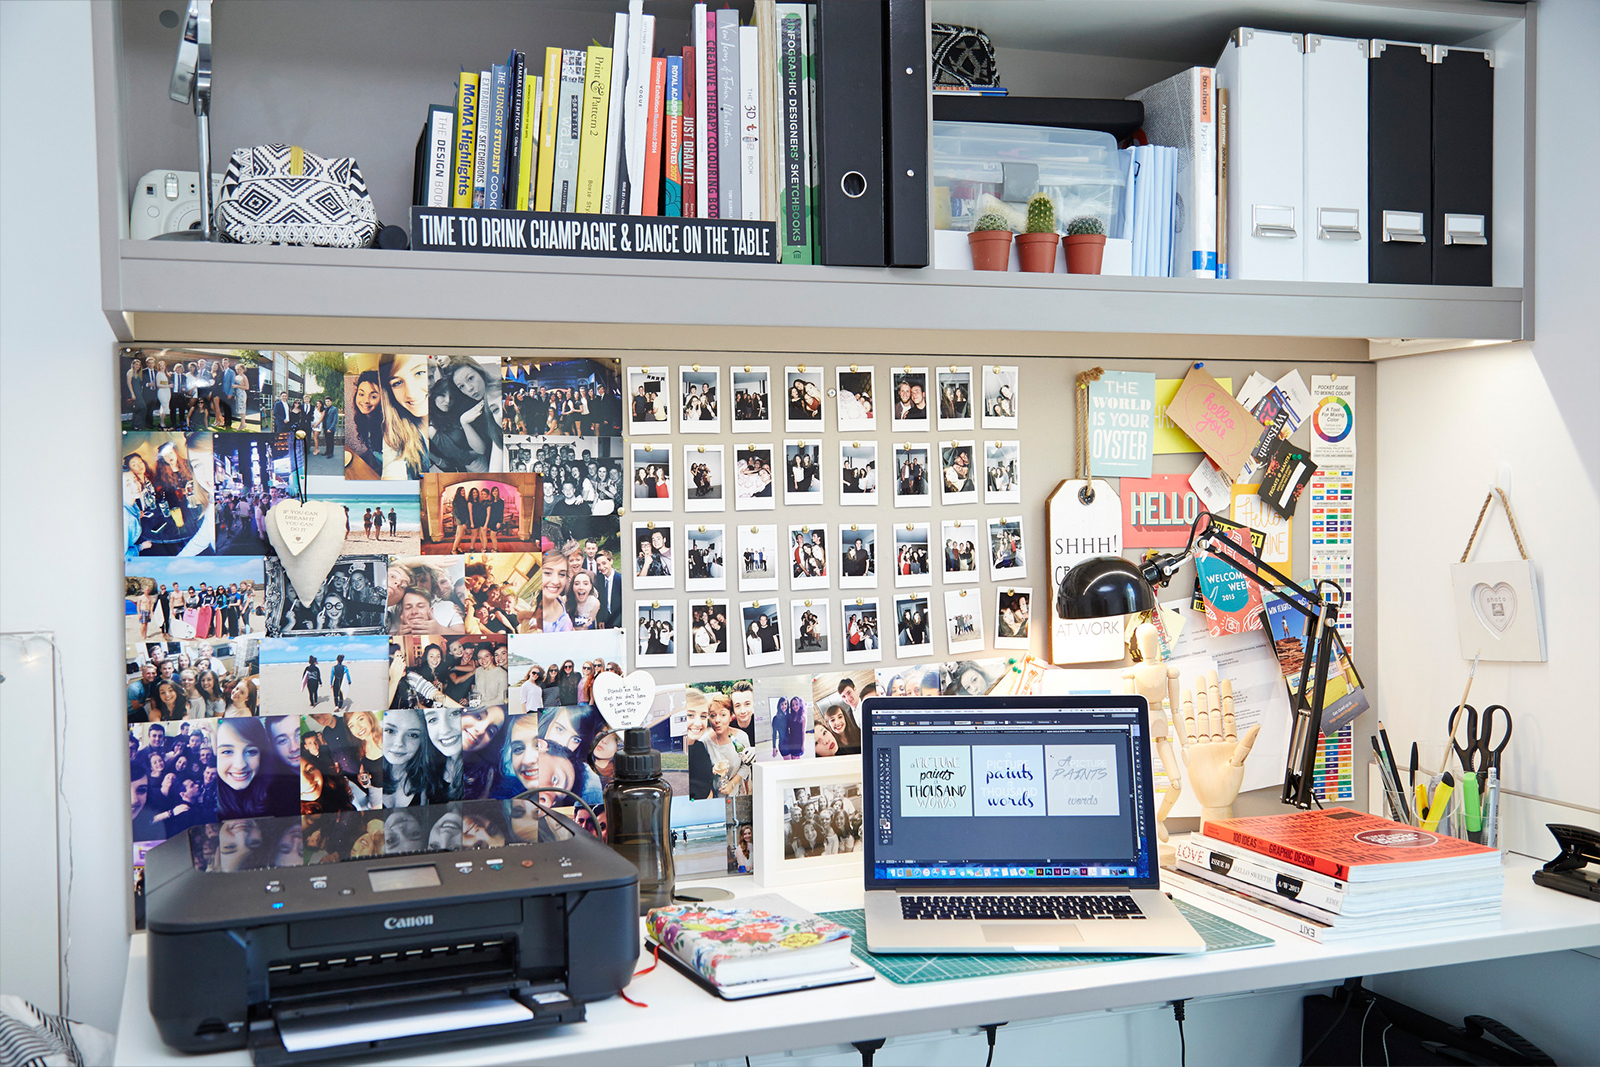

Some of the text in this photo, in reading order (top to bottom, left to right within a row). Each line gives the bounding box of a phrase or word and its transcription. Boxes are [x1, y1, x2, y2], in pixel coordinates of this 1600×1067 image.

[720, 21, 736, 40] New
[549, 54, 557, 77] Summer
[594, 56, 605, 79] Print
[707, 40, 716, 88] CREATIVE
[787, 22, 797, 96] INFOGRAPHIC
[516, 89, 523, 98] DE
[547, 78, 555, 106] Exhibition
[590, 80, 605, 96] &
[1202, 75, 1210, 116] bauhaus
[514, 98, 522, 131] LEMPICKA
[590, 96, 602, 129] Pattern
[707, 90, 717, 133] THERAPY
[745, 105, 756, 119] 3D
[438, 117, 448, 136] THE
[476, 77, 490, 184] EXTRAORDINARY SKETCHBOOKS
[491, 71, 506, 175] THE HUNGRY STUDENT
[723, 103, 735, 148] Illustration
[457, 83, 476, 196] MoMA Highlights
[559, 116, 574, 168] walls
[435, 140, 446, 178] DESIGN
[684, 116, 694, 185] JUST DRAW IT!
[707, 137, 717, 194] COLOURING
[790, 164, 801, 242] SKETCHBOOKS
[419, 215, 770, 256] TIME TO DRINK CHAMPAGNE & DANCE ON THE TABLE
[1104, 380, 1139, 395] THE
[1092, 396, 1152, 411] WORLD
[1203, 392, 1235, 430] hello
[1093, 412, 1150, 428] IS YOUR
[1196, 412, 1226, 440] you
[1093, 429, 1147, 460] OYSTER
[1258, 413, 1287, 458] WHSmith
[1280, 453, 1293, 474] MANTRA
[1131, 492, 1199, 526] HELLO
[1237, 497, 1283, 528] Hello
[1055, 534, 1117, 555] SHHH!
[1228, 580, 1252, 592] WEEK
[1056, 621, 1120, 637] AT WORK
[915, 757, 960, 768] PICTURE
[986, 759, 1029, 769] PICTURE
[1071, 759, 1107, 768] PICTURE
[920, 768, 955, 783] paints
[986, 763, 1033, 784] paints
[1052, 768, 1108, 780] PAINTS
[906, 785, 967, 797] THOUSAND
[980, 787, 1038, 797] THOUSAND
[987, 790, 1034, 808] words
[1067, 795, 1098, 806] words
[916, 796, 957, 809] WORDS
[1233, 832, 1257, 848] 100 IDEAS
[1177, 844, 1204, 864] LOVE
[1211, 858, 1224, 867] ISSUE
[1269, 843, 1294, 860] GRAPHIC
[1294, 853, 1315, 867] DESIGN
[1233, 865, 1250, 876] HELLO
[383, 914, 434, 930] Canon
[1299, 924, 1315, 938] EXIT
